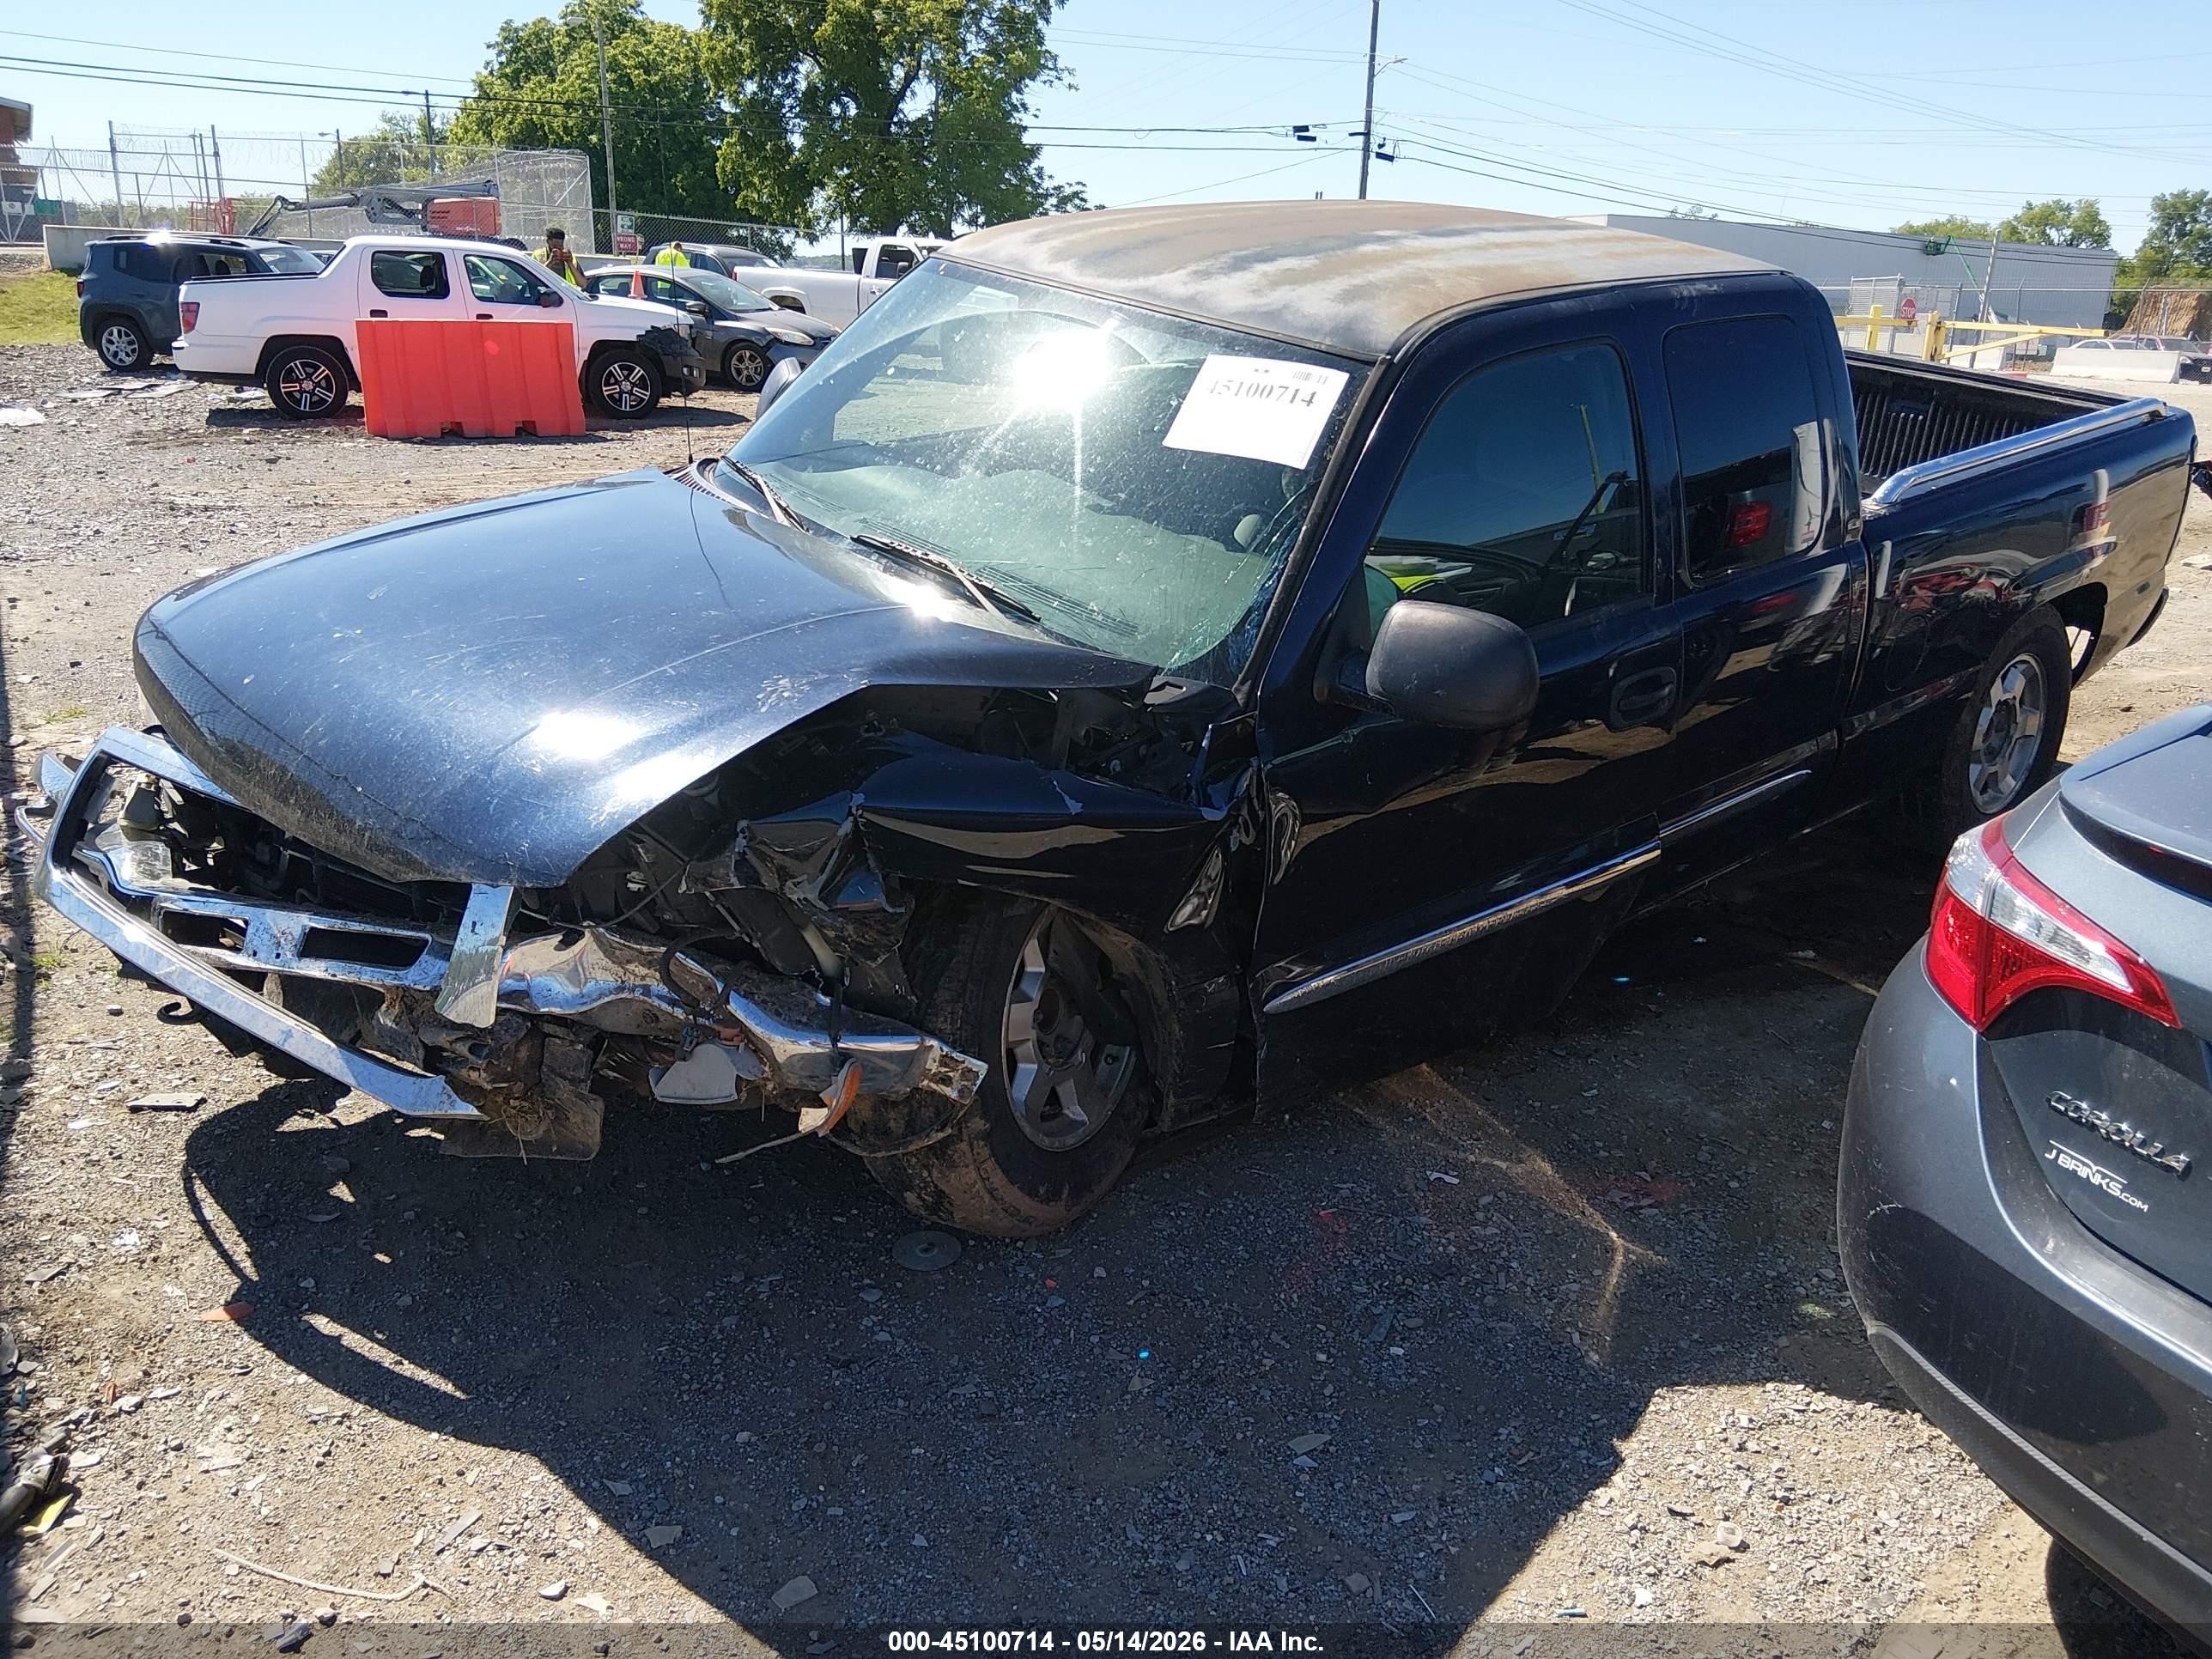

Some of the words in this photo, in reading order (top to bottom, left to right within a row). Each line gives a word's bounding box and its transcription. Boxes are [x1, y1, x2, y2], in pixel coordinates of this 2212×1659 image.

[1901, 307, 1916, 318] STOP
[2047, 1091, 2191, 1177] COROLLA
[2044, 1148, 2057, 1160] J
[2057, 1153, 2149, 1212] BRINKS.COM
